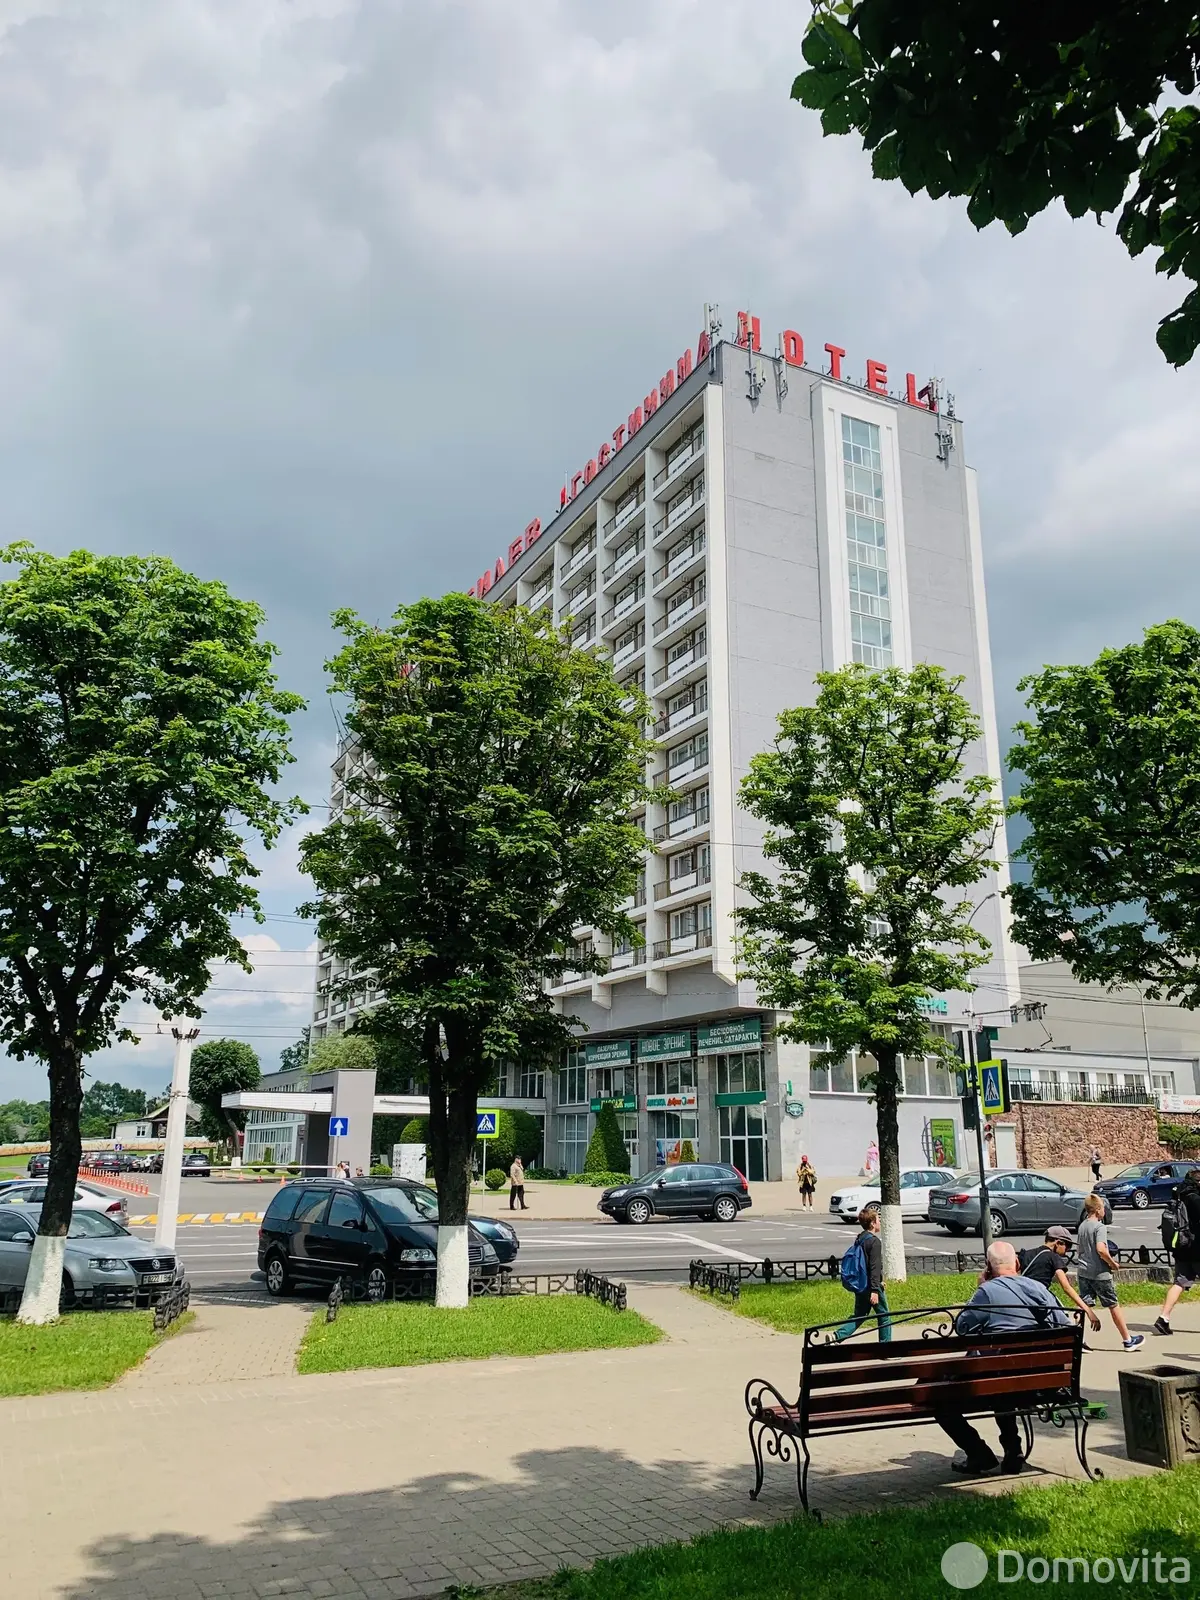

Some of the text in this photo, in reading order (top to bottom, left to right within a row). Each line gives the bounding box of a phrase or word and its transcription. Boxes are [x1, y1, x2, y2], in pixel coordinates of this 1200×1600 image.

[736, 311, 928, 409] HOTEL
[467, 517, 541, 600] ИЛЕВ
[641, 1039, 661, 1053] НОВОЕ
[663, 1035, 686, 1050] ЗРЕНИЕ
